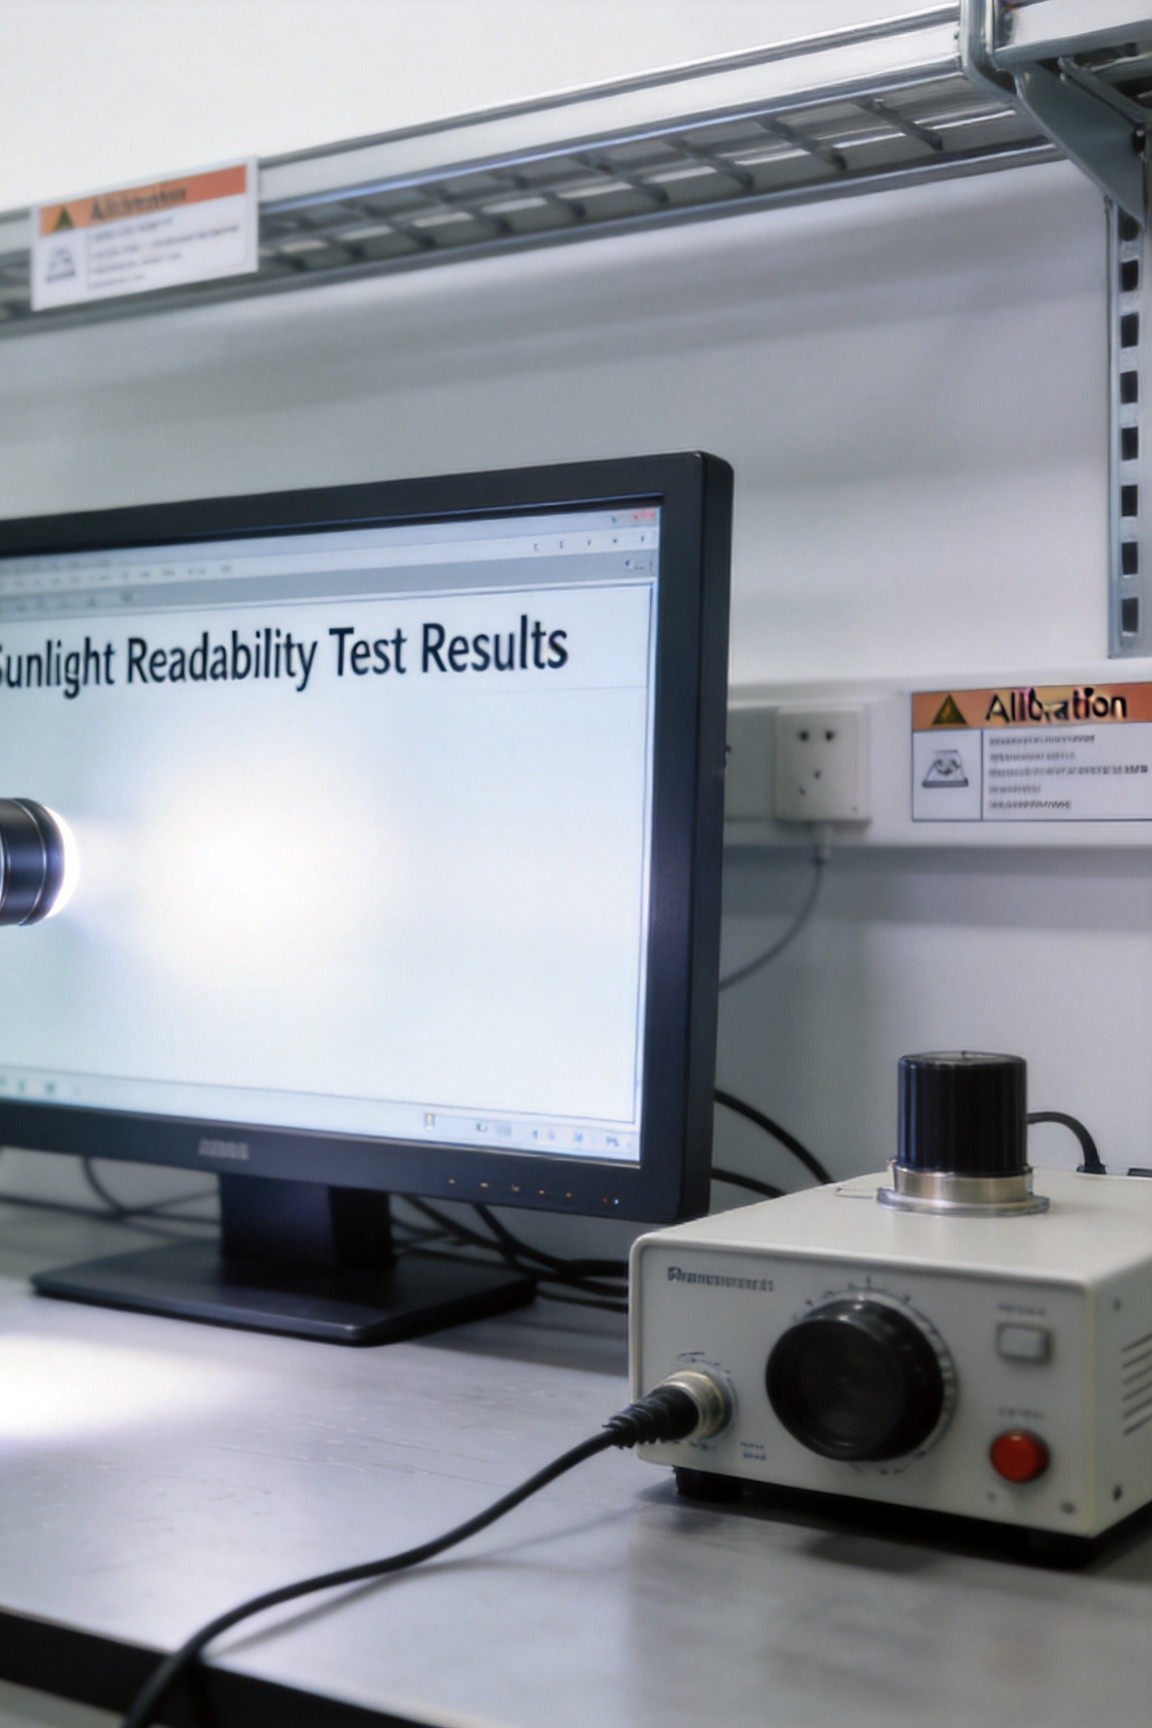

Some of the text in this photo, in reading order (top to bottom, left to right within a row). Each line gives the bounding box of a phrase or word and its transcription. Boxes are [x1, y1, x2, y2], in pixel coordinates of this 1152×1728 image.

[127, 627, 318, 693] Readability
[329, 626, 407, 677] Test
[421, 614, 568, 673] Results
